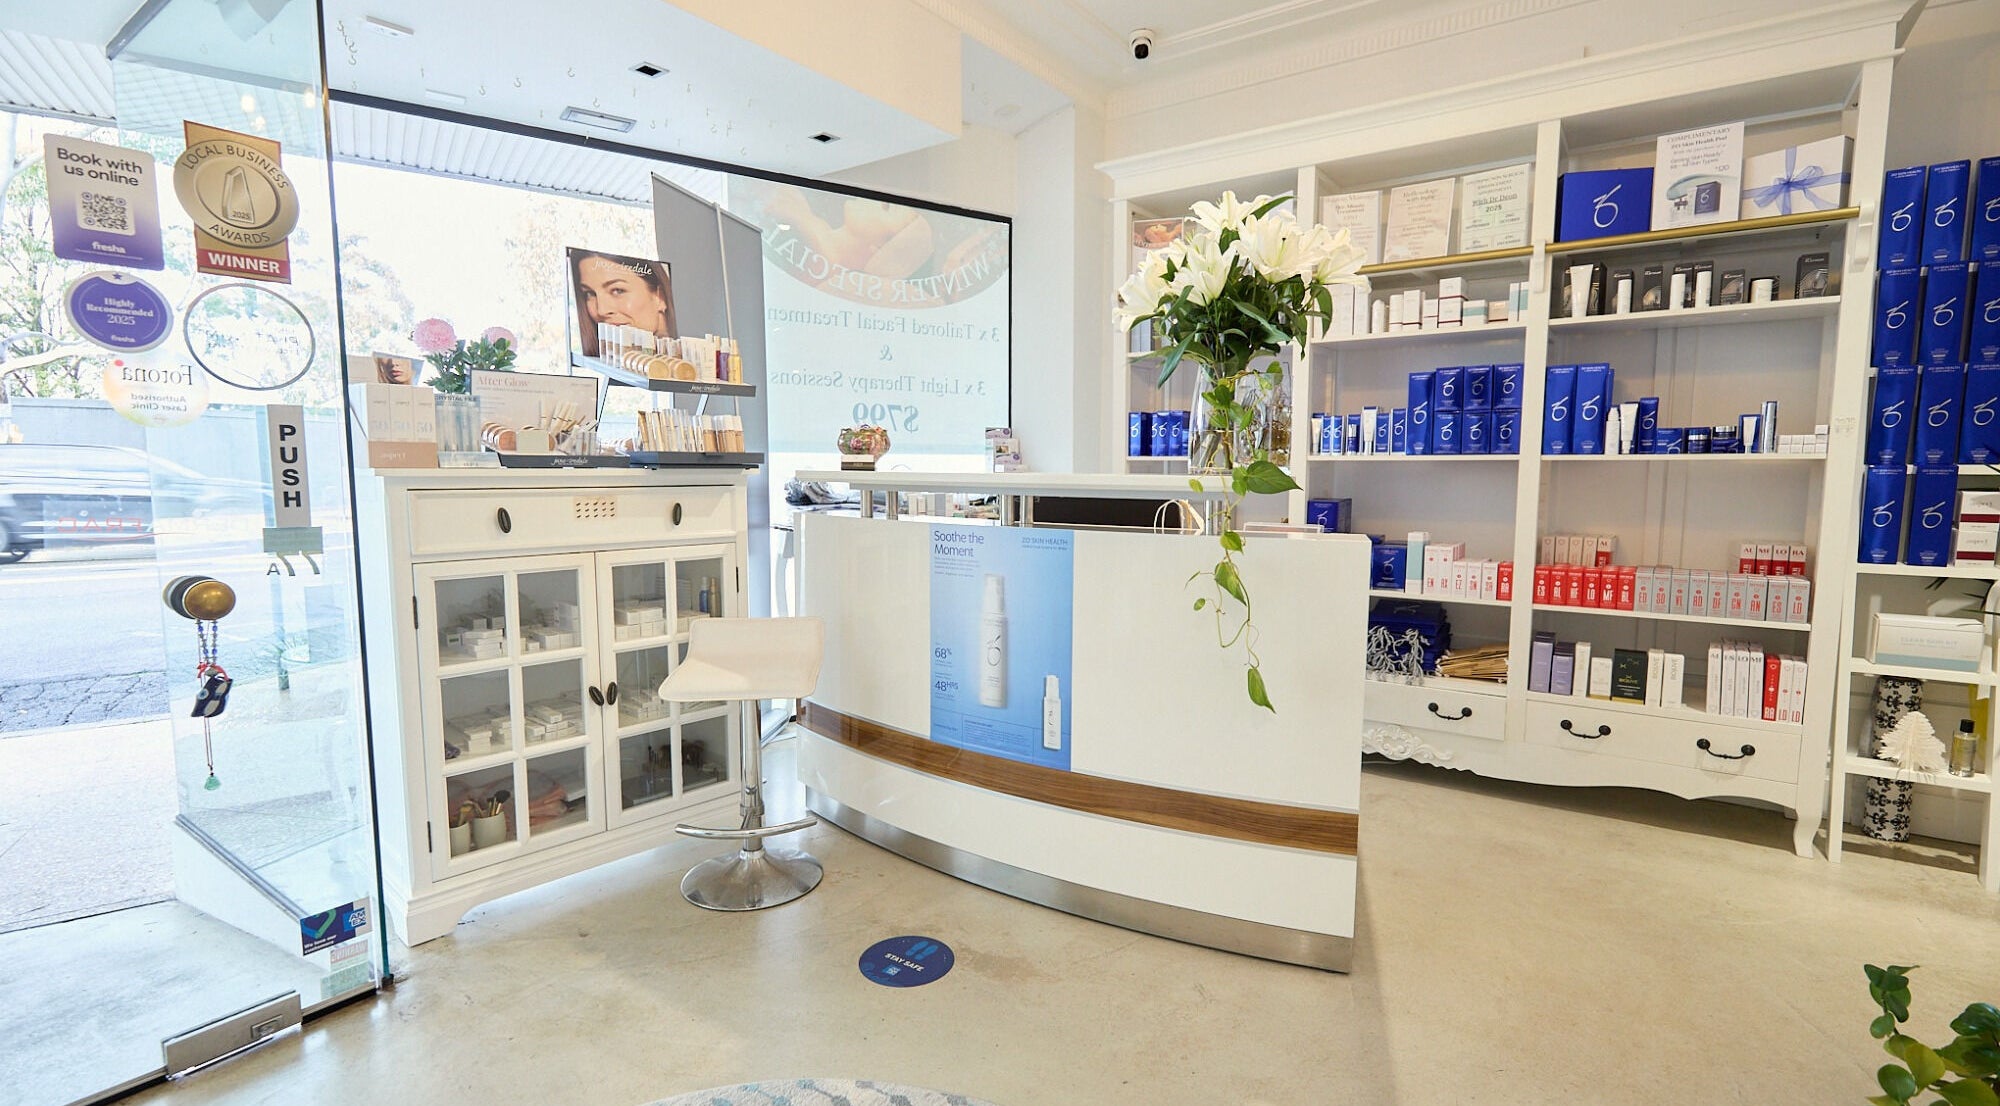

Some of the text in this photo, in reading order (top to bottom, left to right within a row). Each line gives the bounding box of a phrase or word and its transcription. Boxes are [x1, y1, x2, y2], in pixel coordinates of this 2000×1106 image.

[57, 148, 142, 174] Book with
[181, 144, 289, 188] LOCAL BUSINESS
[64, 165, 139, 186] us online
[208, 224, 270, 244] AWARDS
[92, 241, 126, 254] fresha
[208, 252, 280, 274] WINNER
[86, 303, 154, 317] Recommended
[104, 298, 136, 308] Highly
[107, 314, 136, 326] 2025
[278, 424, 302, 508] PUSH
[934, 530, 984, 544] Soothe the
[1045, 538, 1068, 546] HEALTH
[934, 544, 974, 558] Moment
[884, 952, 905, 964] STAY
[904, 960, 925, 972] SAFE
